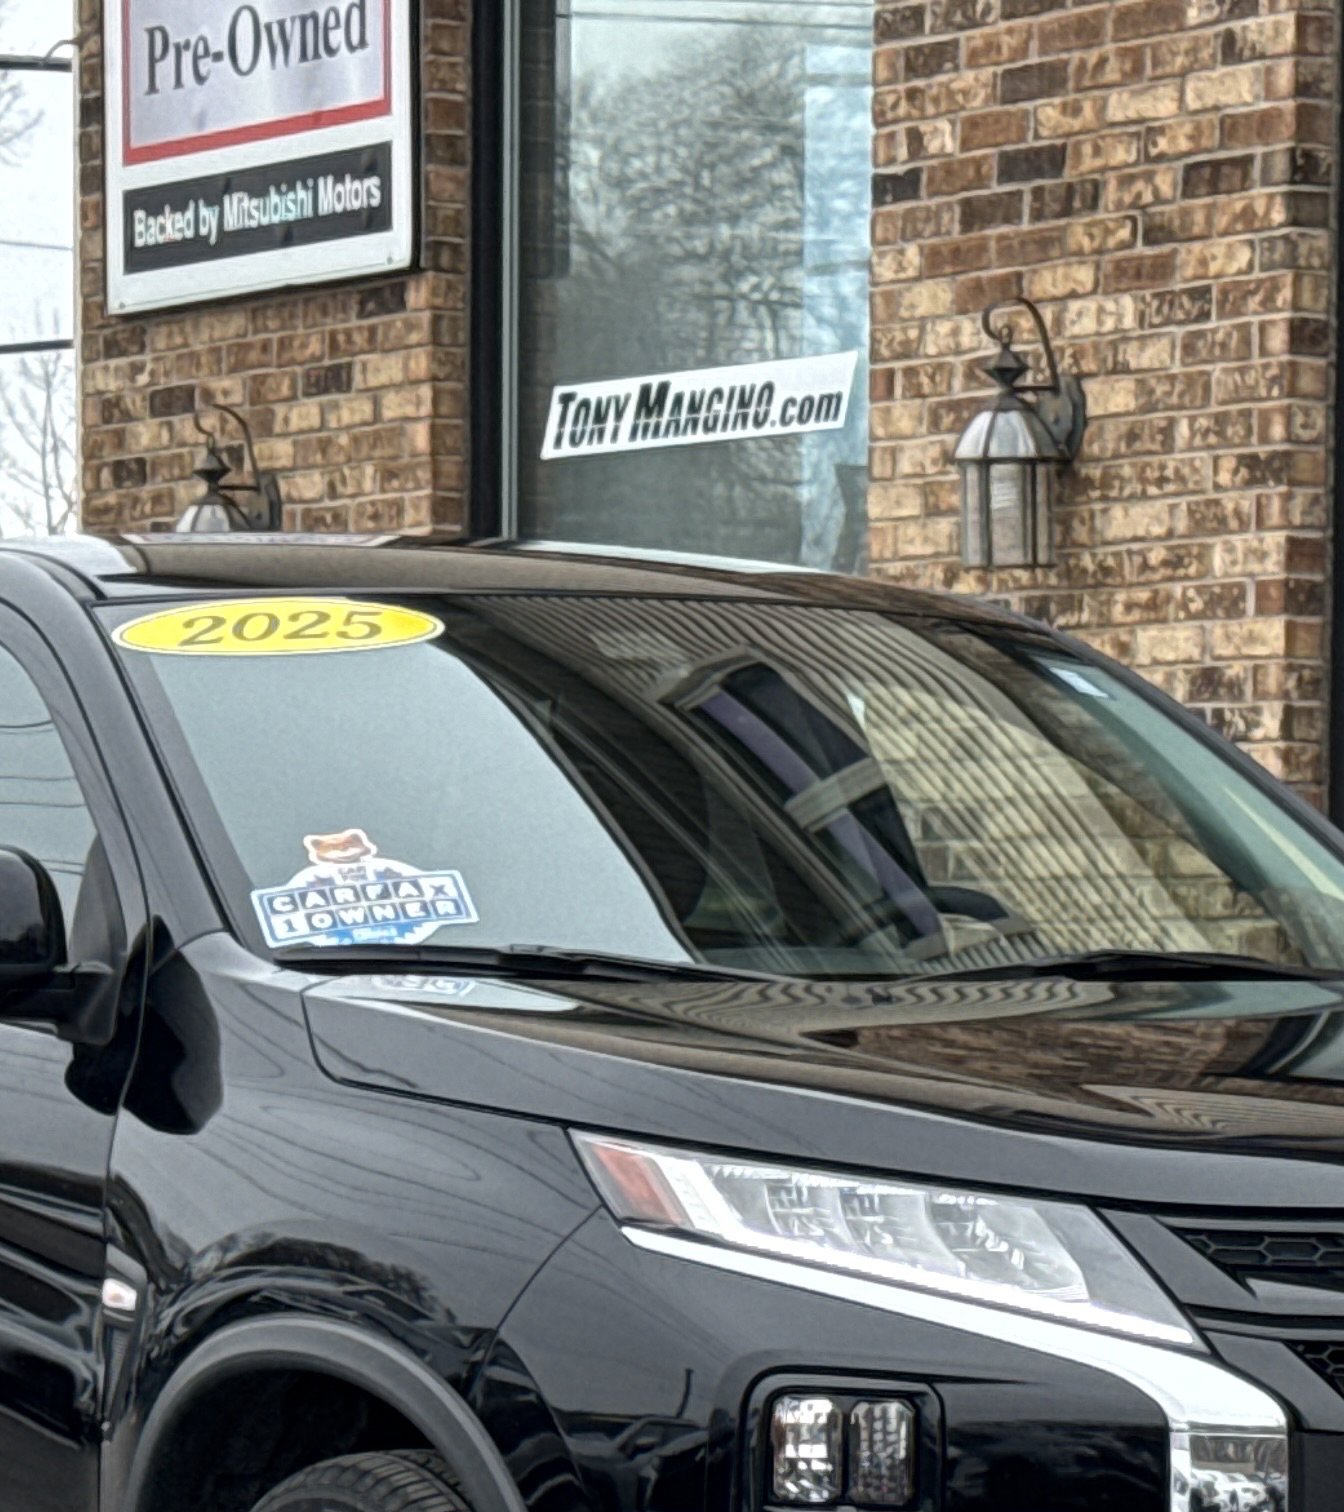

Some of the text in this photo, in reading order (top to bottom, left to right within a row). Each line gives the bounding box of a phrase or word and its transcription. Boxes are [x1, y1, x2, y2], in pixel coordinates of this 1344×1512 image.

[144, 1, 370, 96] Pre-Owned
[133, 174, 382, 248] Backed by Mitsubishi Motors
[177, 610, 383, 647] 2025
[271, 881, 453, 912] CARFAX
[311, 900, 457, 929] OWNER
